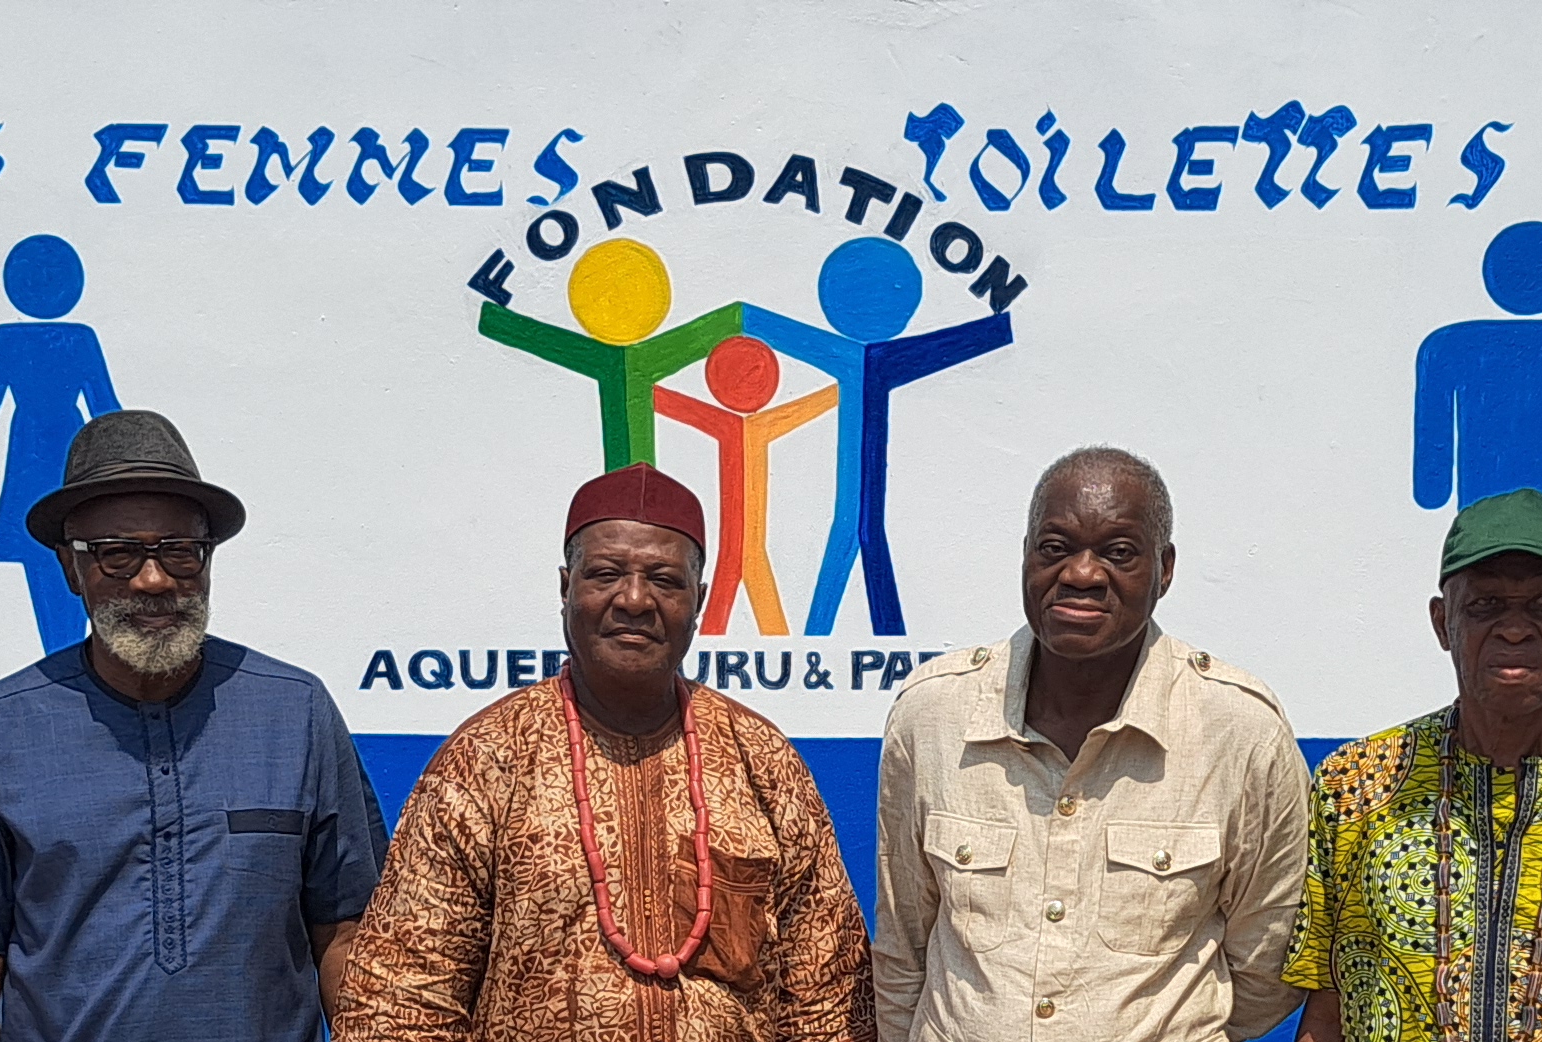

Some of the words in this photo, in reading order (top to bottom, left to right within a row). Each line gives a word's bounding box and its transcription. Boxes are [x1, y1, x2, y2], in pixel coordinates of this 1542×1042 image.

[84, 123, 585, 207] FEMMES
[466, 151, 1029, 312] FONDATION
[803, 650, 834, 691] &
